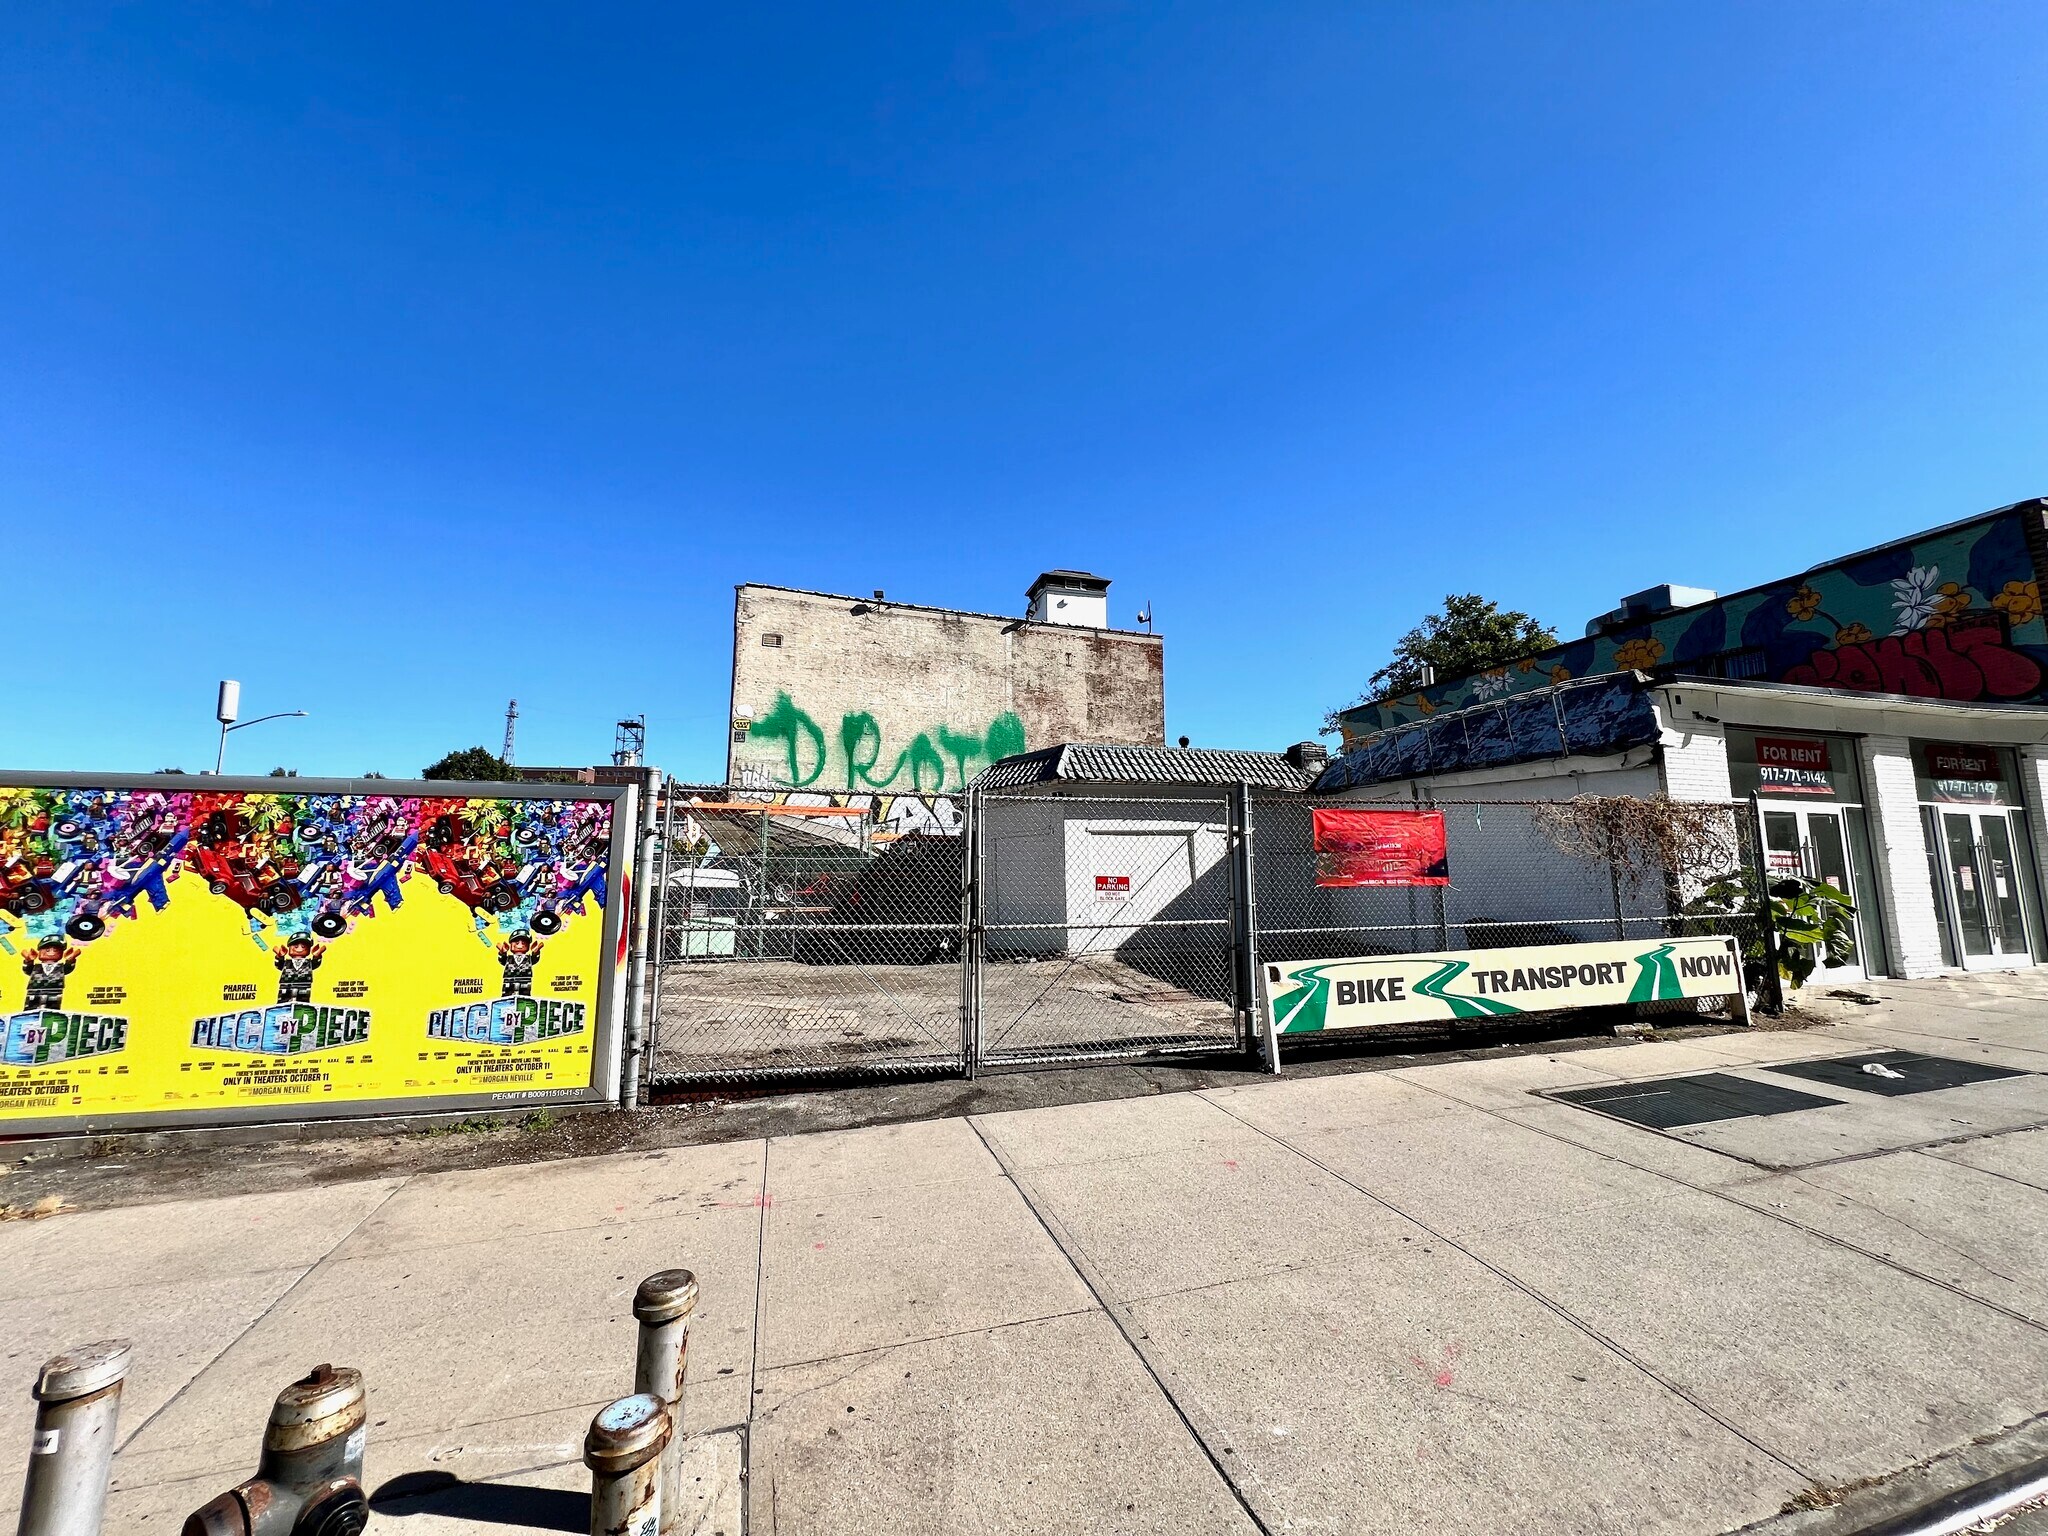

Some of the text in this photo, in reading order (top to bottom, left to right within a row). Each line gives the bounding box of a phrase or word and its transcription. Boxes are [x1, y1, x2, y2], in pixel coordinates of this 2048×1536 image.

[1763, 746, 1821, 763] FOR RENT
[1936, 756, 1986, 772] FOR RENT
[453, 978, 484, 987] PHARRELL
[1336, 954, 1733, 1006] BIKE TRANSPORT NOW
[223, 984, 257, 993] PHARRELL
[453, 986, 483, 994] WILLIAMS
[223, 992, 256, 1000] WILLIAMS
[428, 998, 515, 1043] PIECE
[505, 1012, 521, 1026] BY
[513, 997, 585, 1043] PIECE
[192, 1004, 292, 1053] PIECE
[280, 1020, 297, 1035] BY
[288, 1004, 370, 1053] PIECE
[26, 1029, 46, 1044] BY
[34, 1011, 127, 1063] PIECE
[456, 1062, 550, 1074] ONLY IN THEATERS OCTOBER 11
[223, 1073, 330, 1086] ONLY IN THEATERS OCTOBER 11
[482, 1074, 533, 1083] MORGAN NEVILLE
[0, 1085, 79, 1096] HEATERS OCTOBER 11
[252, 1085, 310, 1095] MORGAN NEVILLE
[492, 1092, 520, 1100] PERMIT
[0, 1097, 57, 1108] ORGAN NEVILLE
